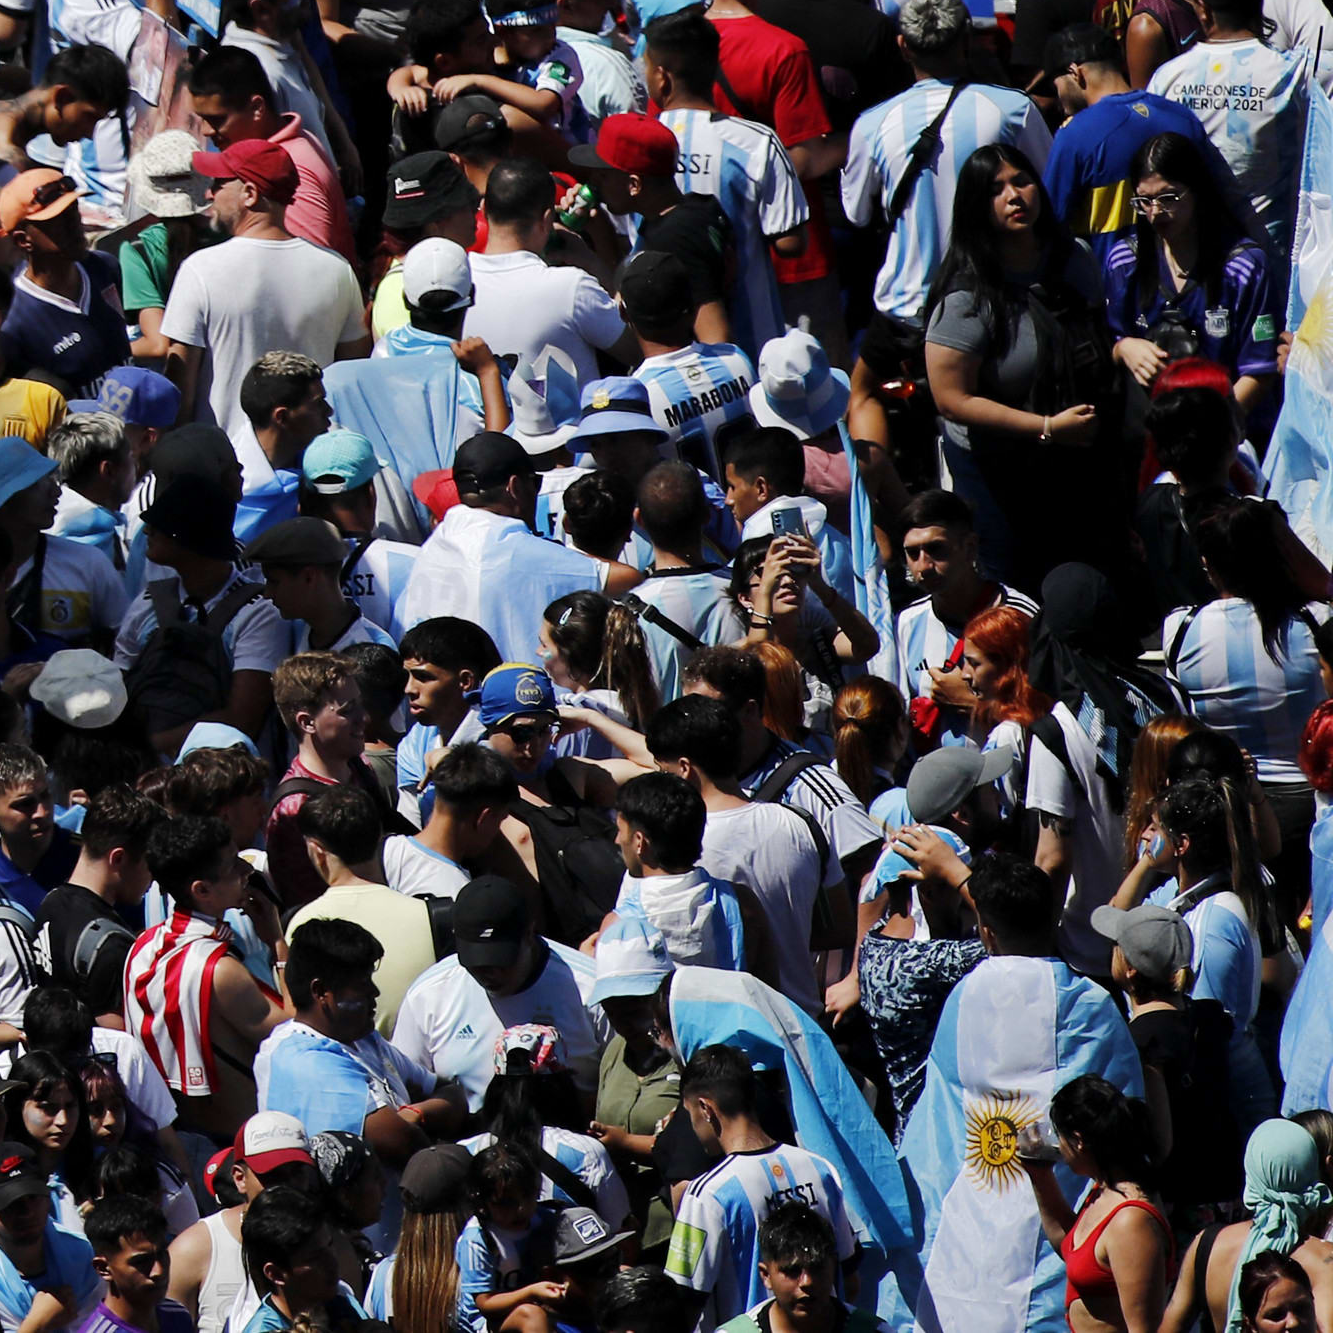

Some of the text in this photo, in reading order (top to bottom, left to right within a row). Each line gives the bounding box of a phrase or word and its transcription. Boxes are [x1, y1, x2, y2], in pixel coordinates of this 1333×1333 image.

[1173, 84, 1267, 100] CAMPEONES DE
[1233, 98, 1265, 112] 2021
[676, 153, 712, 176] SSI
[52, 330, 83, 356] mitre
[343, 573, 376, 597] SSI
[764, 1182, 820, 1211] MESSI
